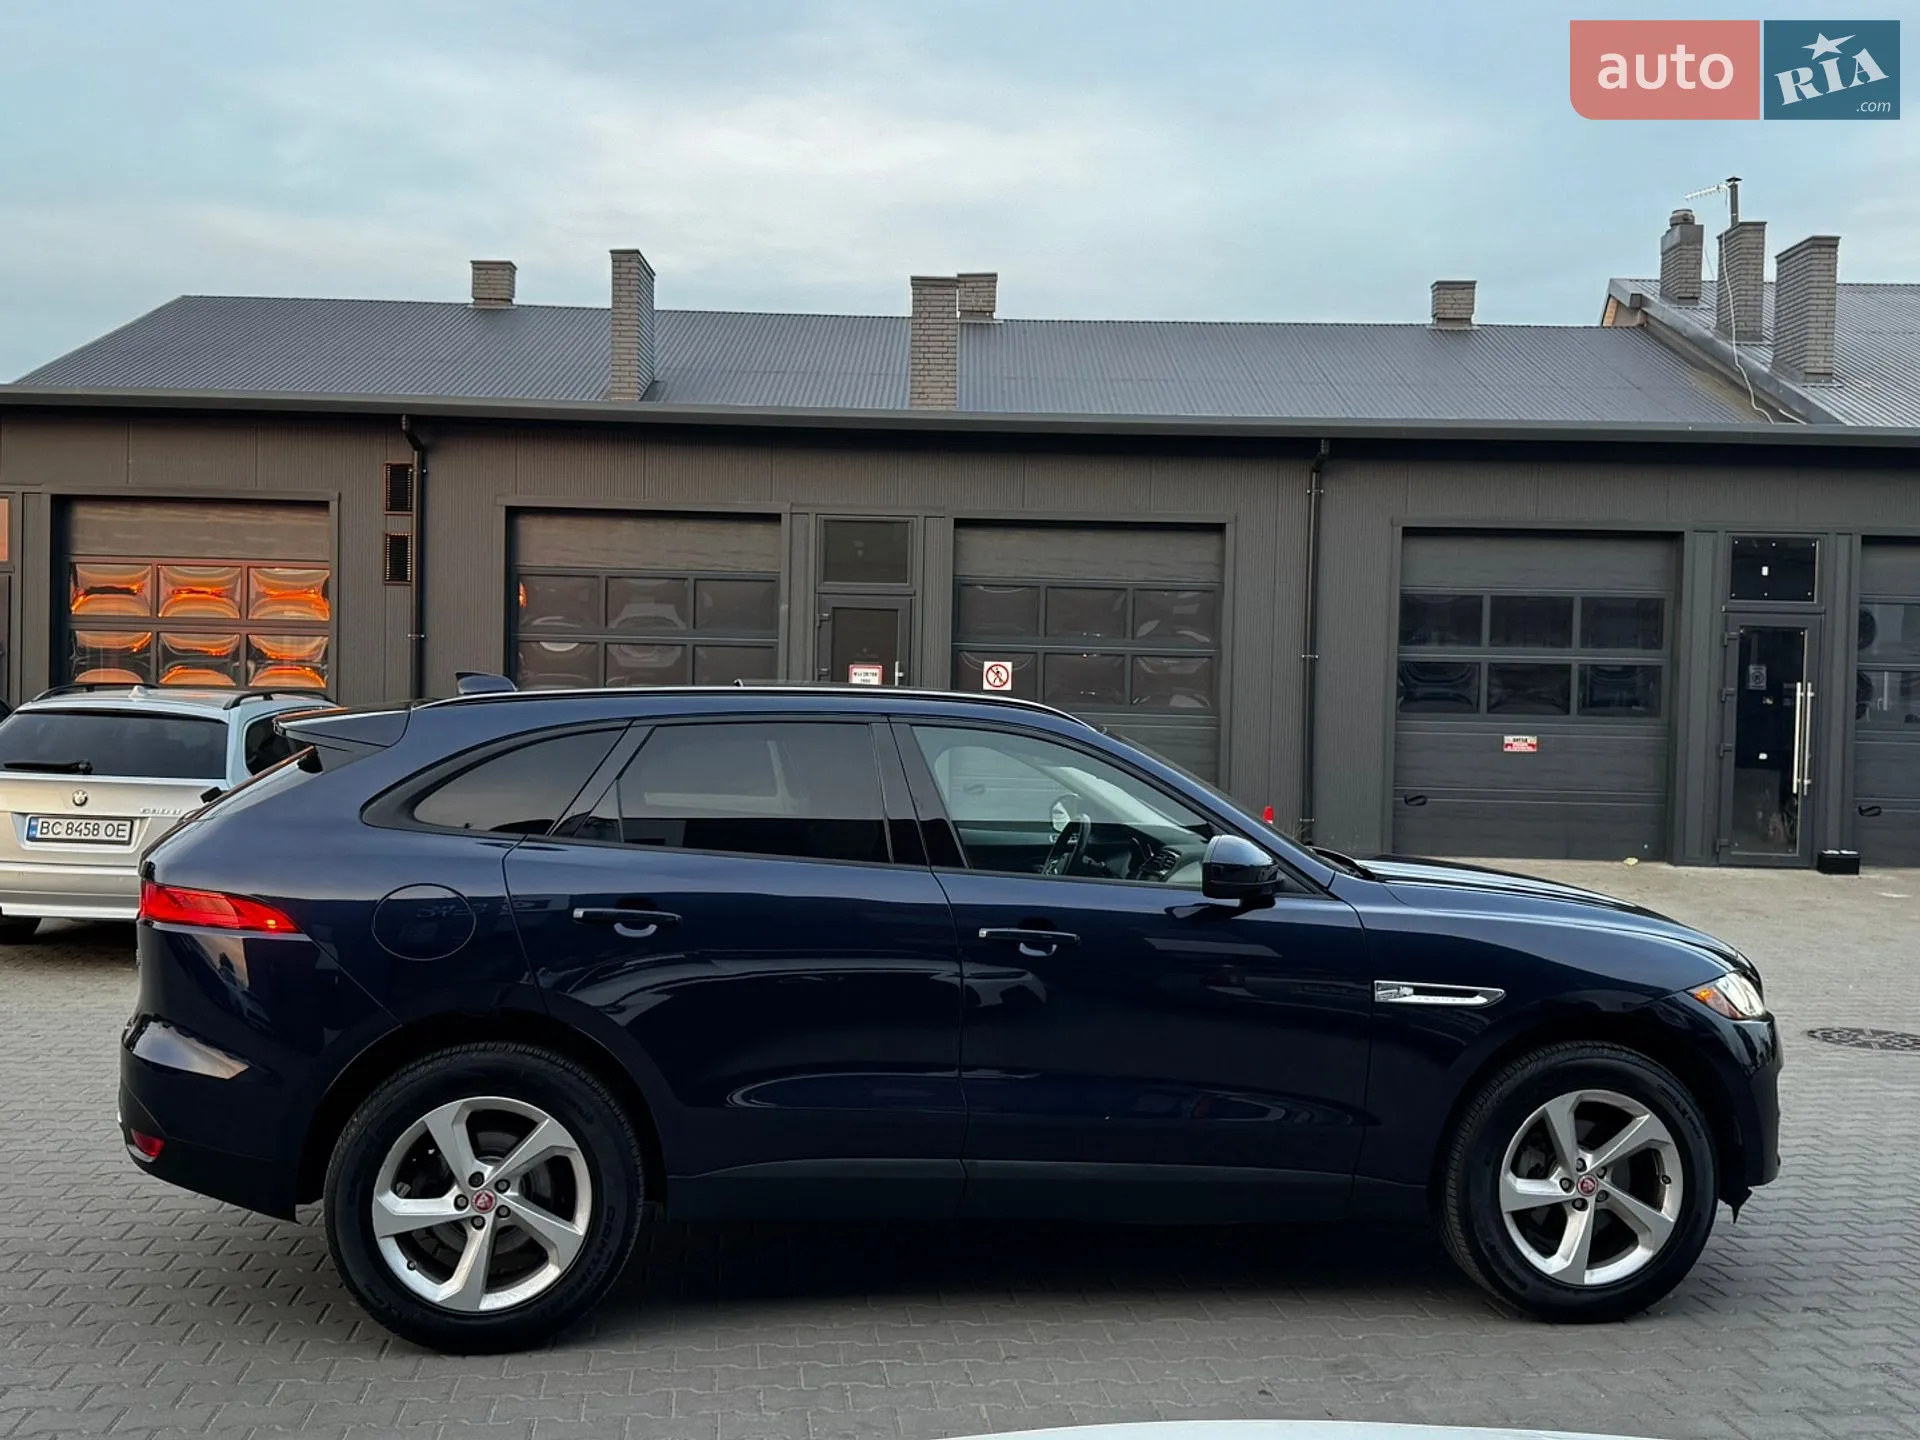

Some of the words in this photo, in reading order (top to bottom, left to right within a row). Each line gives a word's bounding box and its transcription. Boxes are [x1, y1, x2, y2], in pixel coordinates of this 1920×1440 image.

[39, 821, 62, 836] BC
[65, 821, 101, 838] 8458
[104, 823, 128, 839] OE
